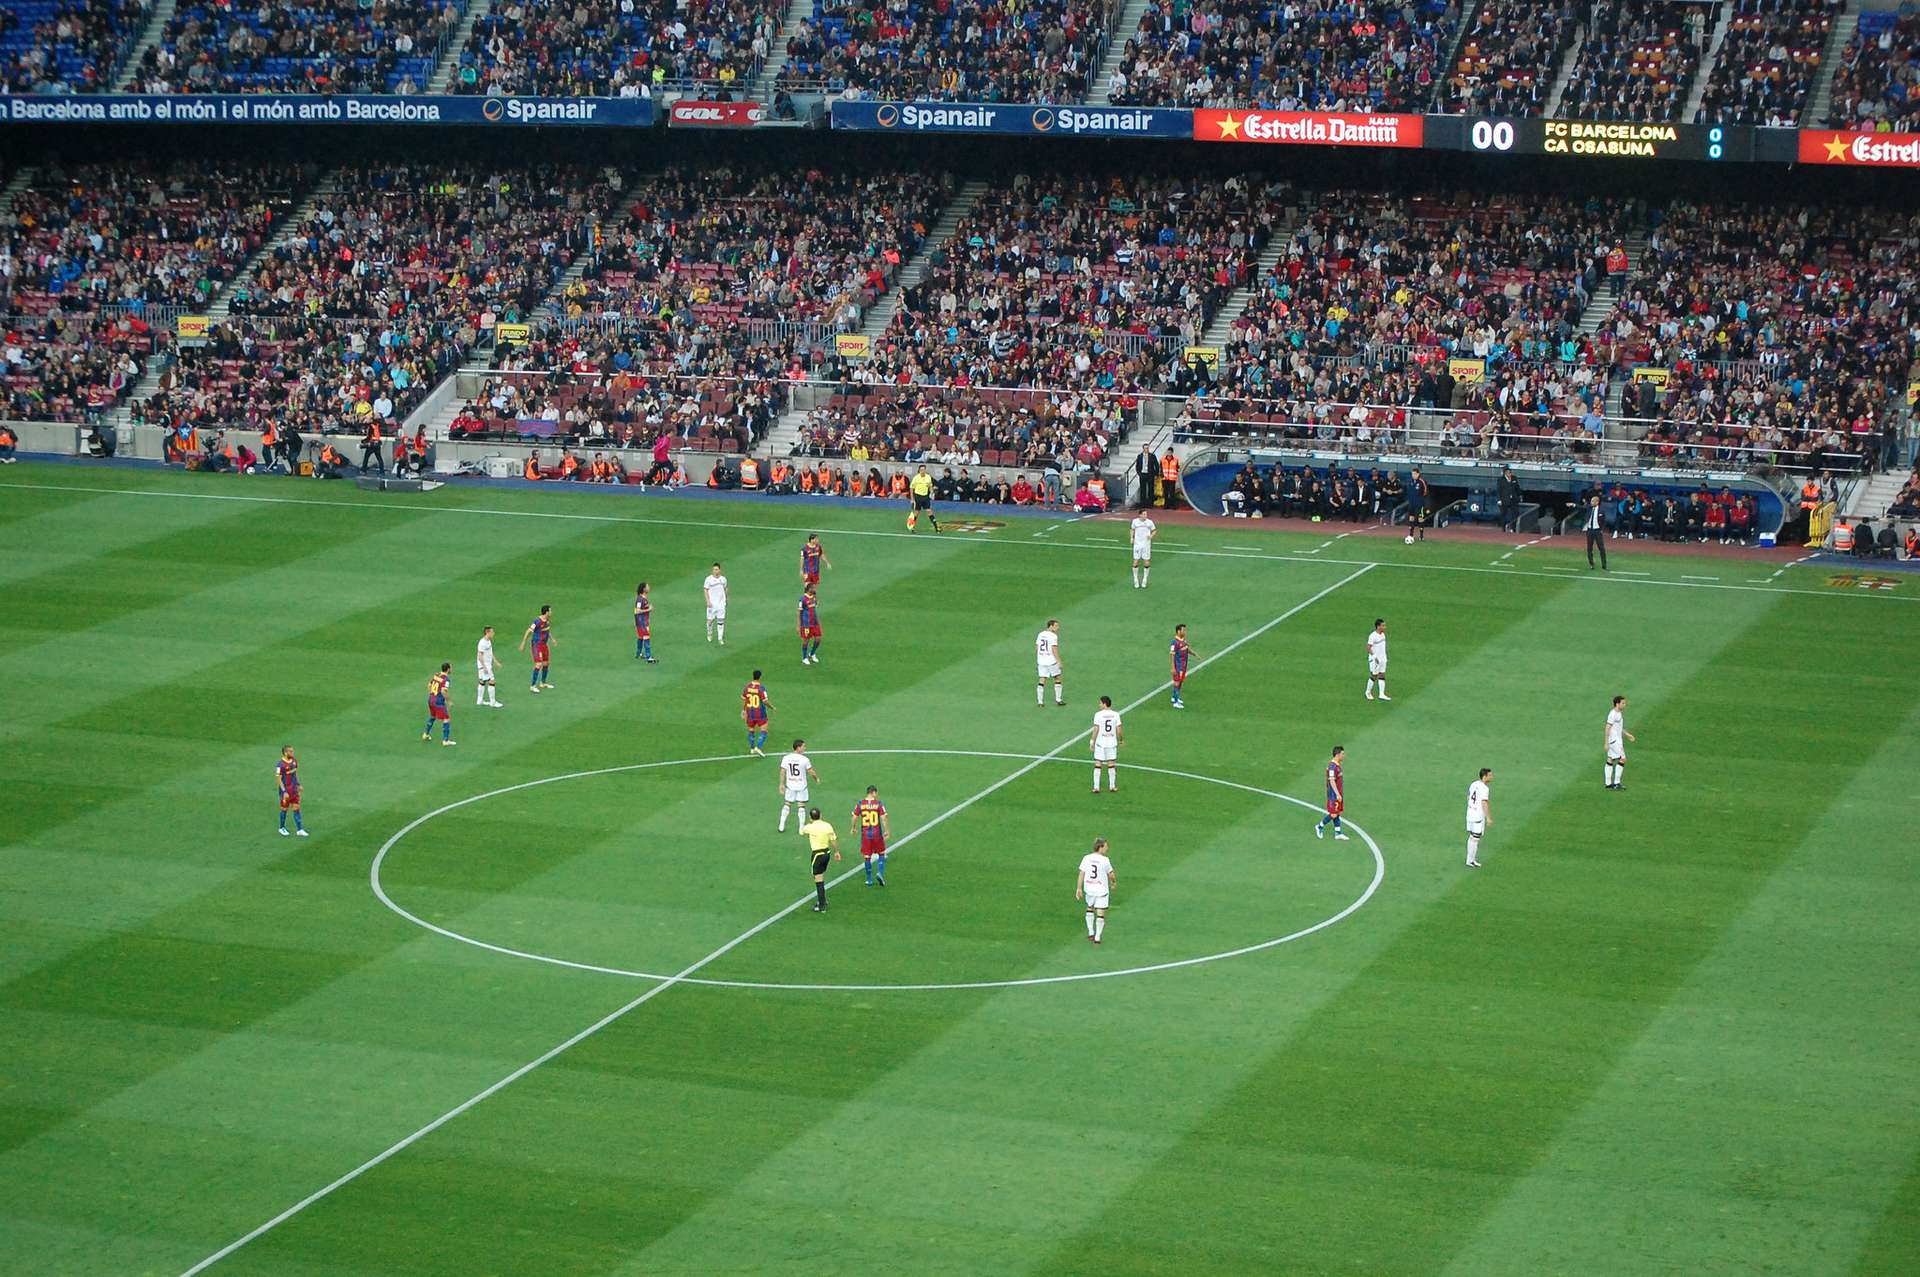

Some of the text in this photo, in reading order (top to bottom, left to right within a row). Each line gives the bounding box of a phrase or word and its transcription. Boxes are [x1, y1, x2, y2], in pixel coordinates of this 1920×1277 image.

[11, 100, 105, 119] Barcelona
[109, 100, 151, 119] amb
[155, 100, 171, 119] el
[175, 100, 216, 120] món
[222, 100, 227, 119] i
[231, 100, 248, 119] el
[253, 100, 294, 119] món
[299, 100, 341, 119] amb
[346, 100, 440, 120] Barcelona
[507, 99, 597, 122] Spanair
[675, 107, 724, 120] GOL
[902, 105, 996, 129] Spanair
[1057, 108, 1153, 133] Spanair
[1243, 113, 1327, 141] Estrella
[1327, 117, 1399, 143] Damm
[1471, 120, 1515, 151] 00
[1544, 122, 1677, 141] FC BARCELONA
[1709, 128, 1722, 142] 0
[1543, 139, 1656, 156] CA OSASUNA
[1709, 144, 1722, 159] 0
[839, 342, 865, 350] SPORT
[1451, 367, 1479, 375] SPORT
[1039, 639, 1048, 651] 21
[746, 693, 760, 708] 30
[1105, 719, 1112, 733] 6
[788, 762, 801, 777] 16
[1470, 790, 1477, 804] 4
[862, 811, 878, 826] 20
[1090, 864, 1098, 879] 3
